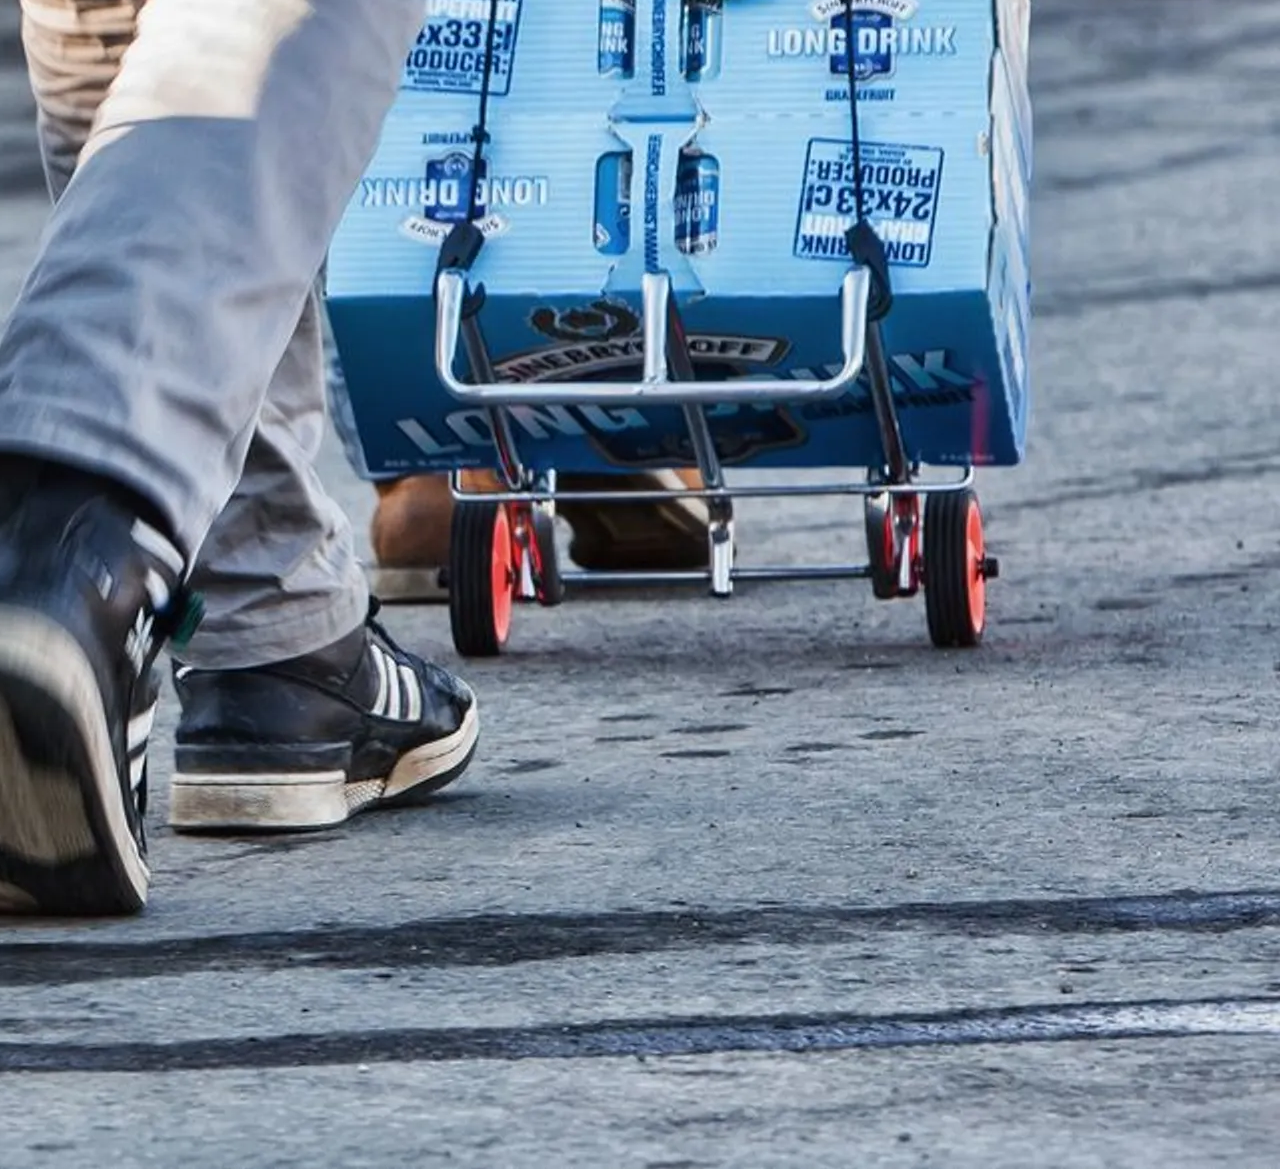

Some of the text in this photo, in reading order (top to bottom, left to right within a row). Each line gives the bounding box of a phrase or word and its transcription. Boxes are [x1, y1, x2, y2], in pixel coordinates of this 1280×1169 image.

[767, 27, 956, 57] LONG DRINK
[363, 178, 548, 207] LONG DRINK
